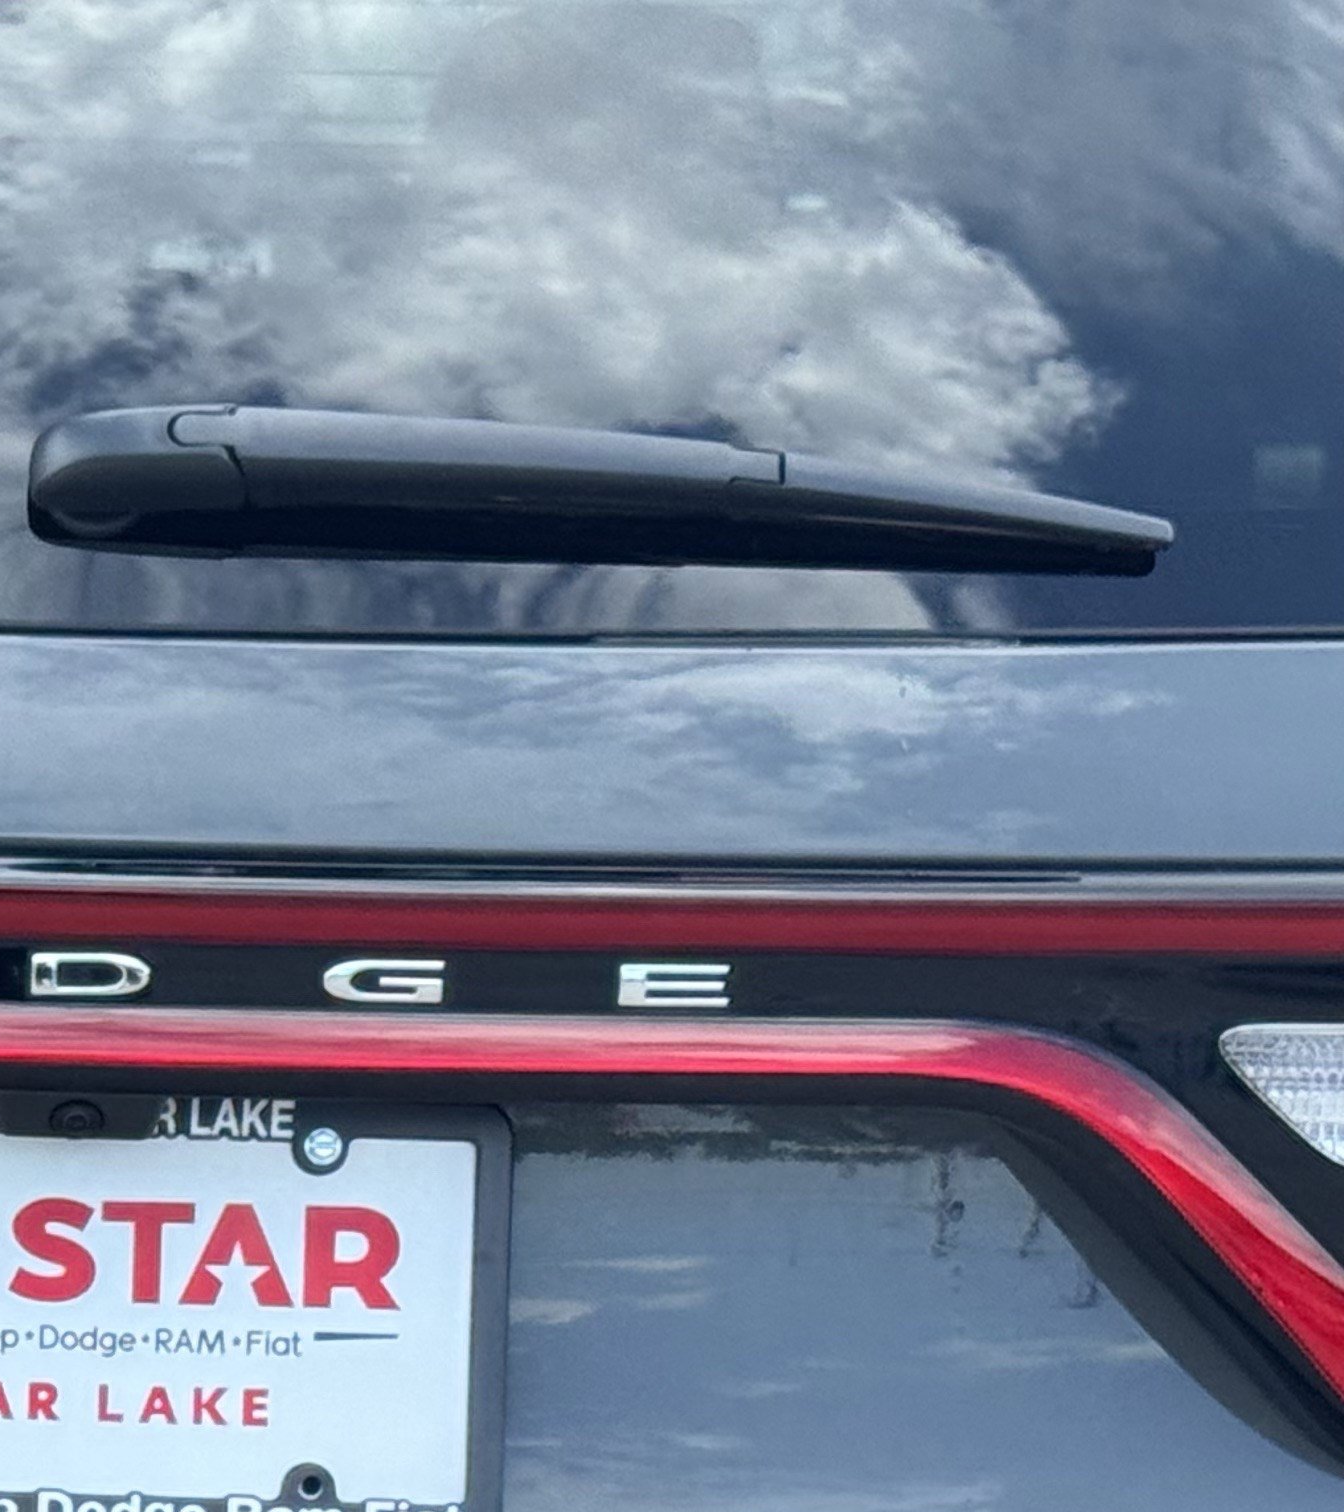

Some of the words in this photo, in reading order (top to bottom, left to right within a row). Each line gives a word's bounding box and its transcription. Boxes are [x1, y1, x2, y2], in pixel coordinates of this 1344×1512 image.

[189, 1097, 296, 1139] LAKE
[9, 1198, 400, 1310] STAR
[38, 1323, 137, 1359] Dodge
[154, 1327, 226, 1355] RAM
[245, 1330, 303, 1357] Fiat
[97, 1383, 270, 1427] LAKE
